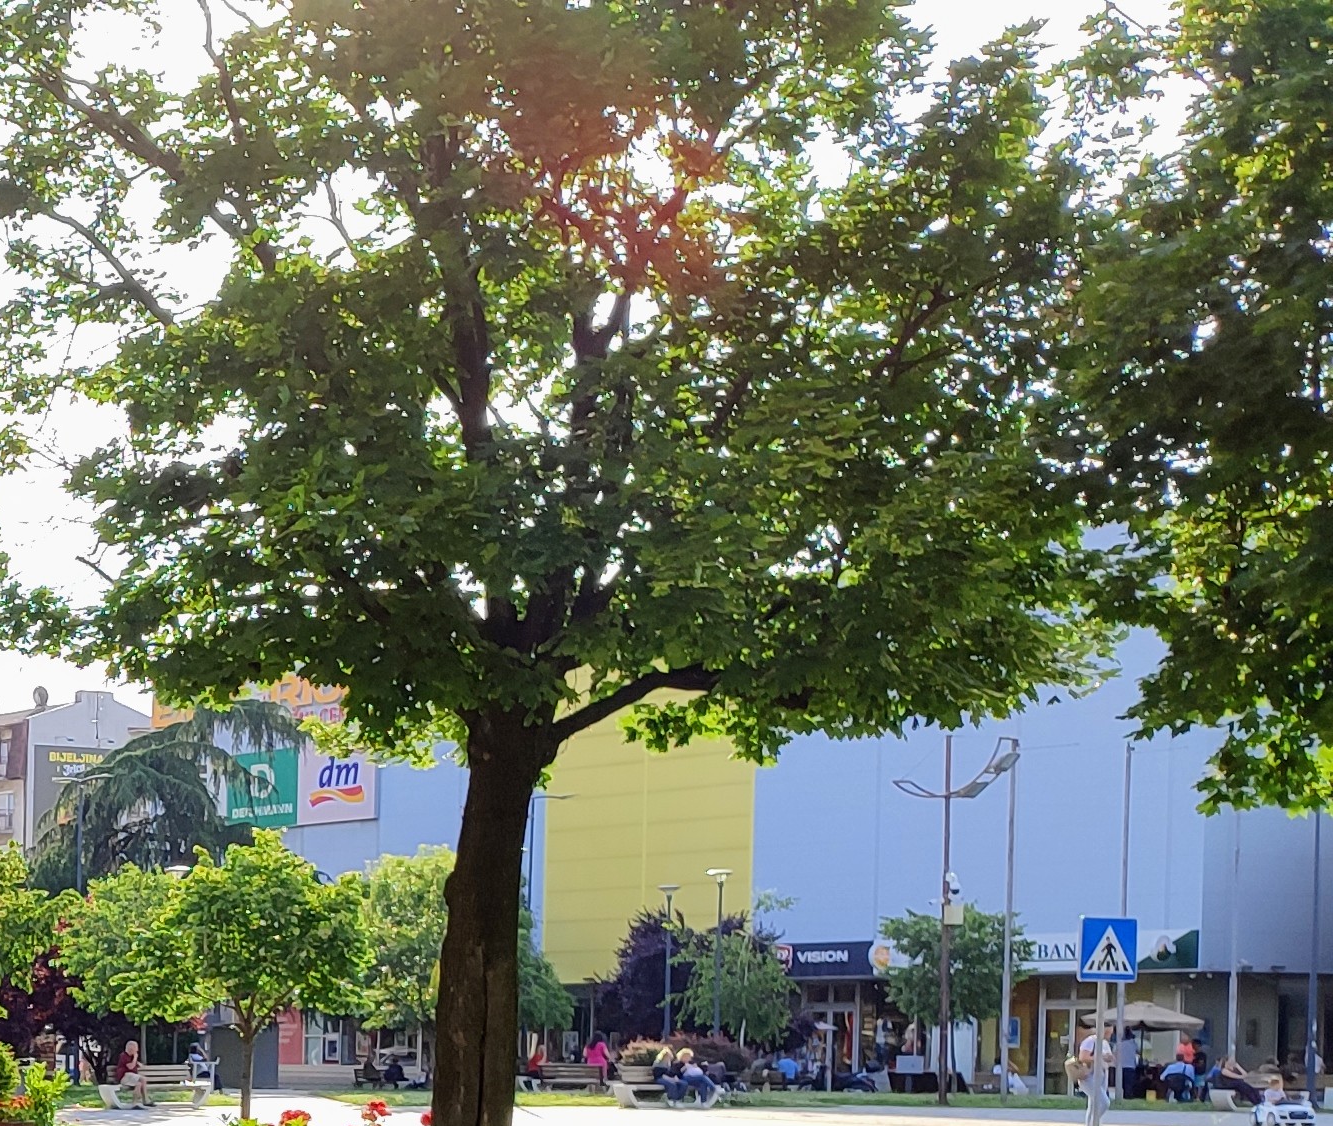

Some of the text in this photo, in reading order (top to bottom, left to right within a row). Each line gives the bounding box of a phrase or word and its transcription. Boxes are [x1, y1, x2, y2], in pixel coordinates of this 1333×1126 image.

[319, 754, 359, 789] dm
[796, 950, 849, 963] VISION
[1037, 943, 1077, 959] BAN
